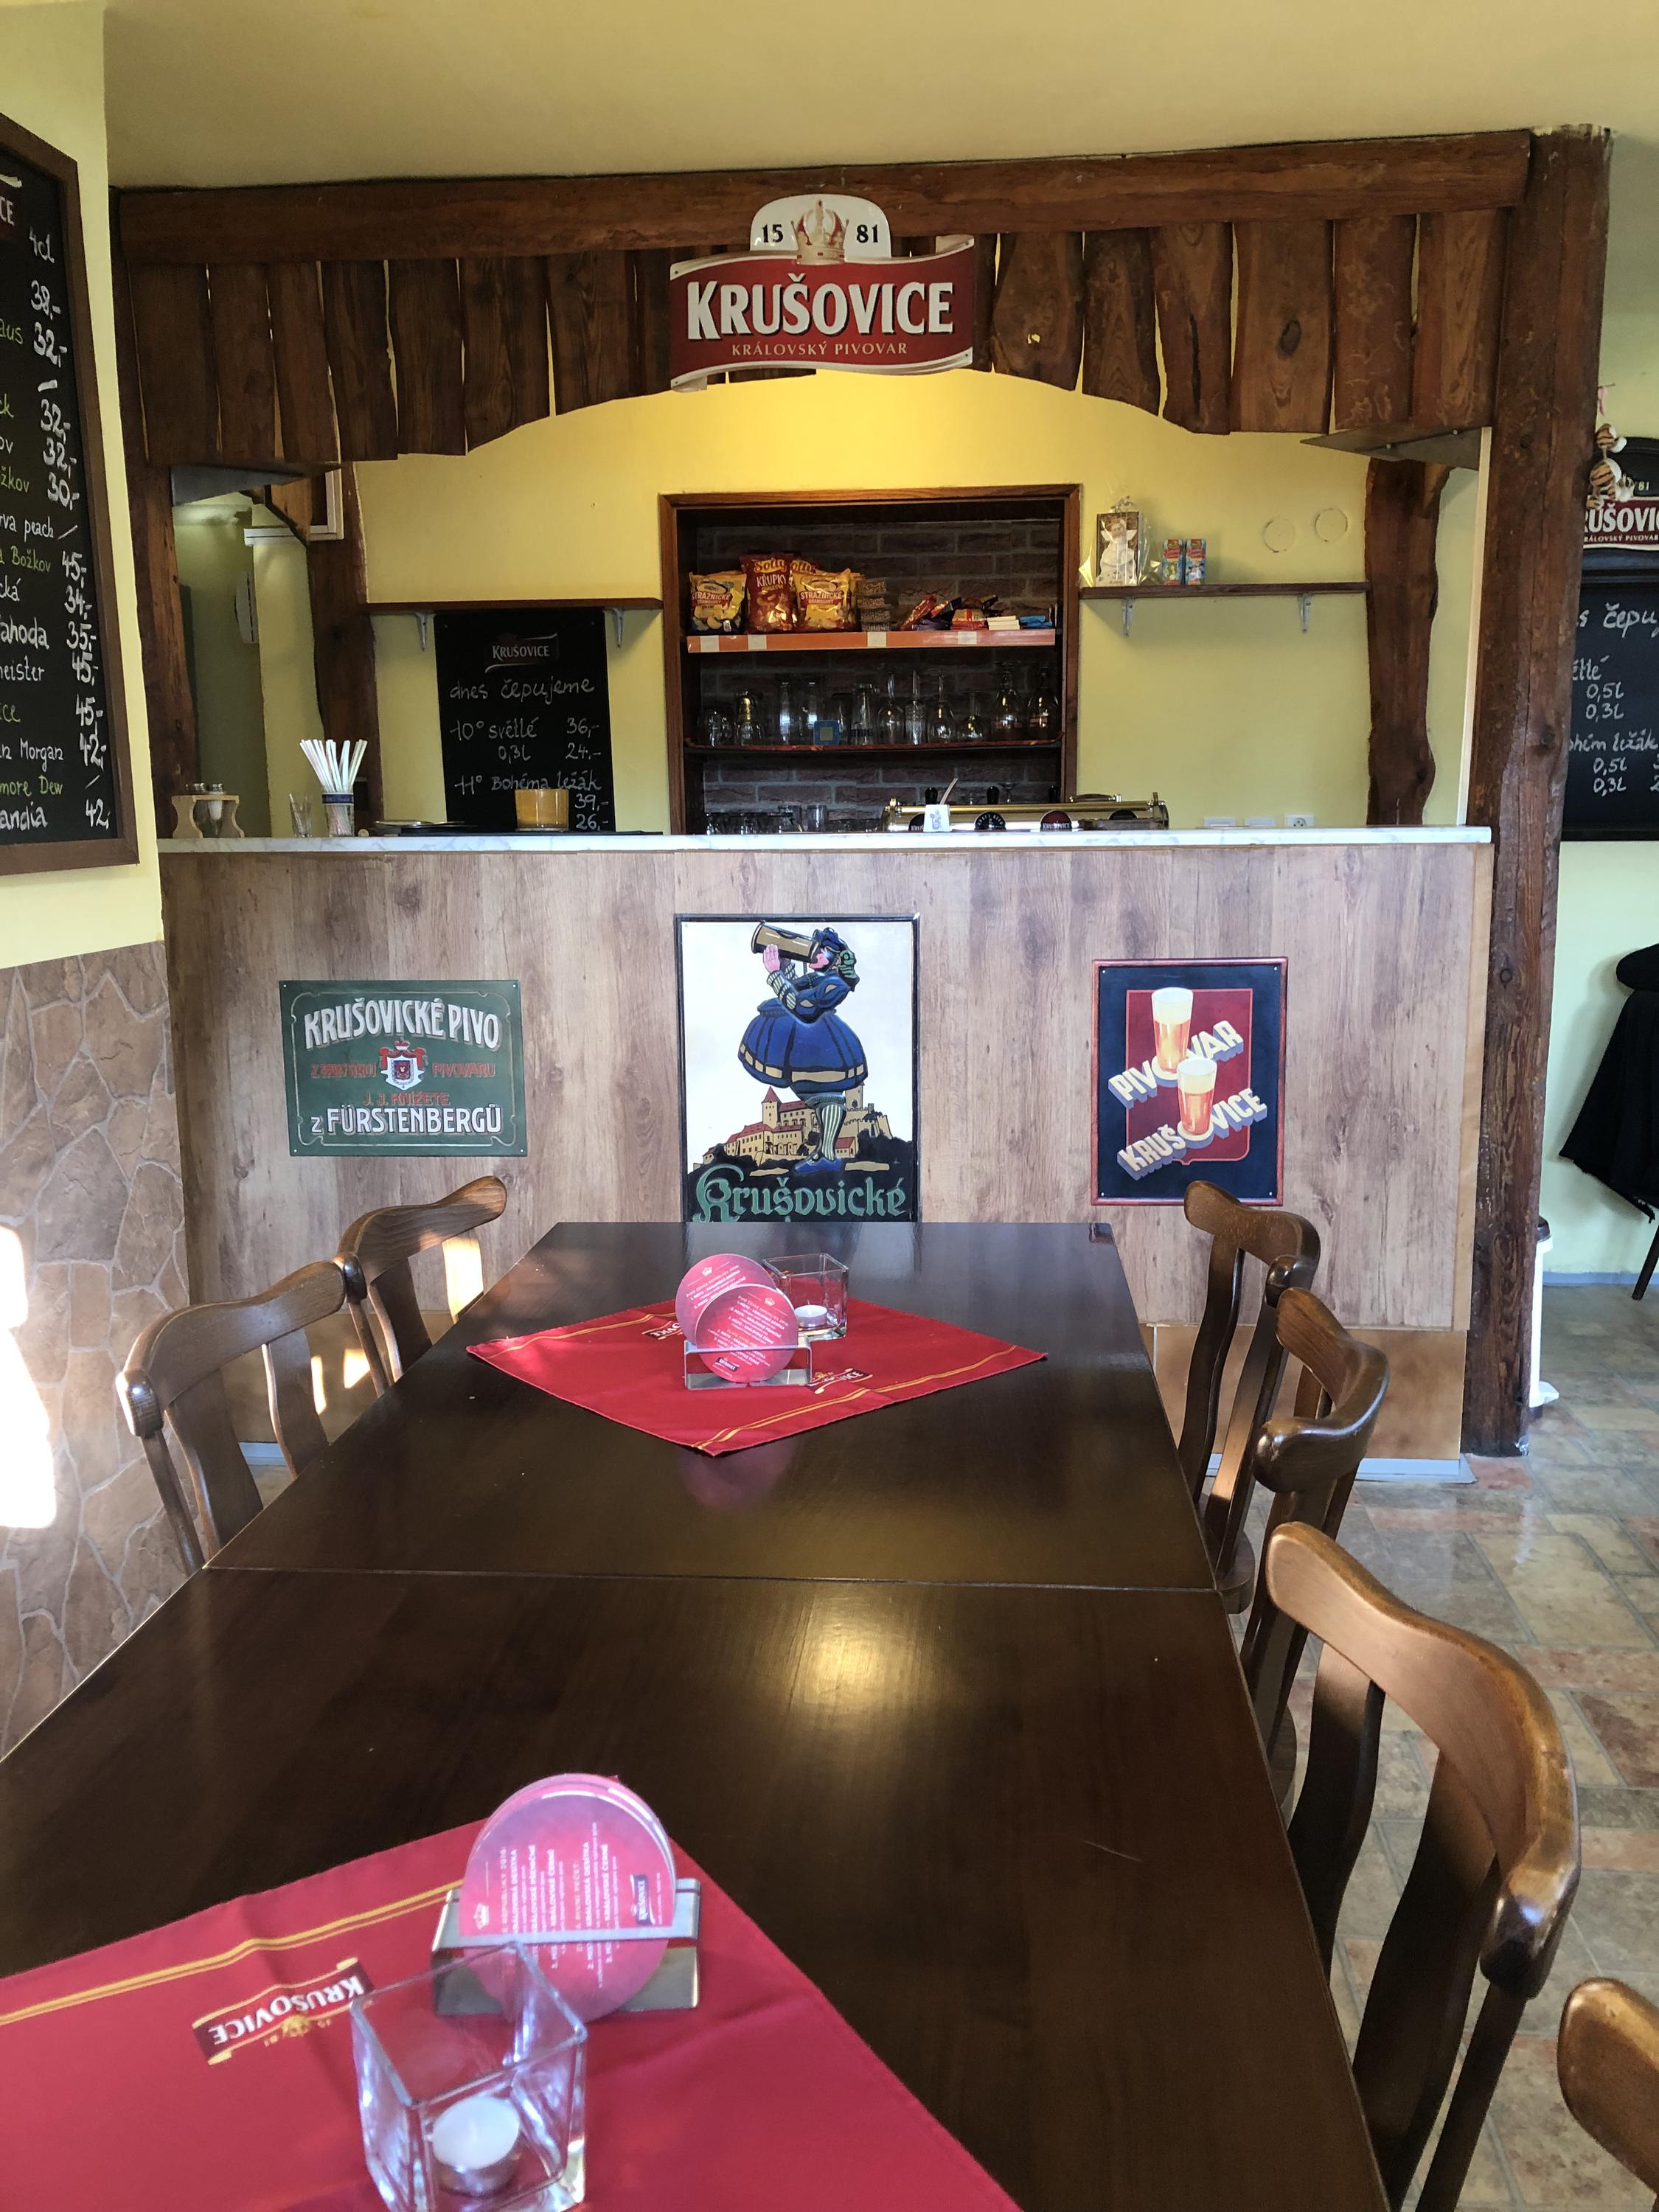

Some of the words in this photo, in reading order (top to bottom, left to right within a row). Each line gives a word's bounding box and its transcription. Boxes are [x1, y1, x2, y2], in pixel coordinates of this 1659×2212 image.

[761, 223, 784, 243] 15
[856, 223, 880, 243] 81
[686, 272, 954, 341] KRUŠOVICE
[731, 341, 827, 356] KRÁLOVSKÝ
[835, 341, 908, 355] PIVOVAR
[24, 515, 54, 543] peach
[10, 546, 51, 573] Božkov
[0, 613, 49, 650] ahoda
[449, 679, 489, 700] dnes
[501, 676, 595, 705] čepujeme
[20, 737, 64, 772] Morgan
[38, 774, 63, 795] Dew
[304, 997, 445, 1050] KRUŠOVICKÉ
[447, 1004, 501, 1051] PIVO
[327, 1105, 503, 1135] FÜRSTENBERGŮ
[692, 1164, 907, 1222] Krušovické
